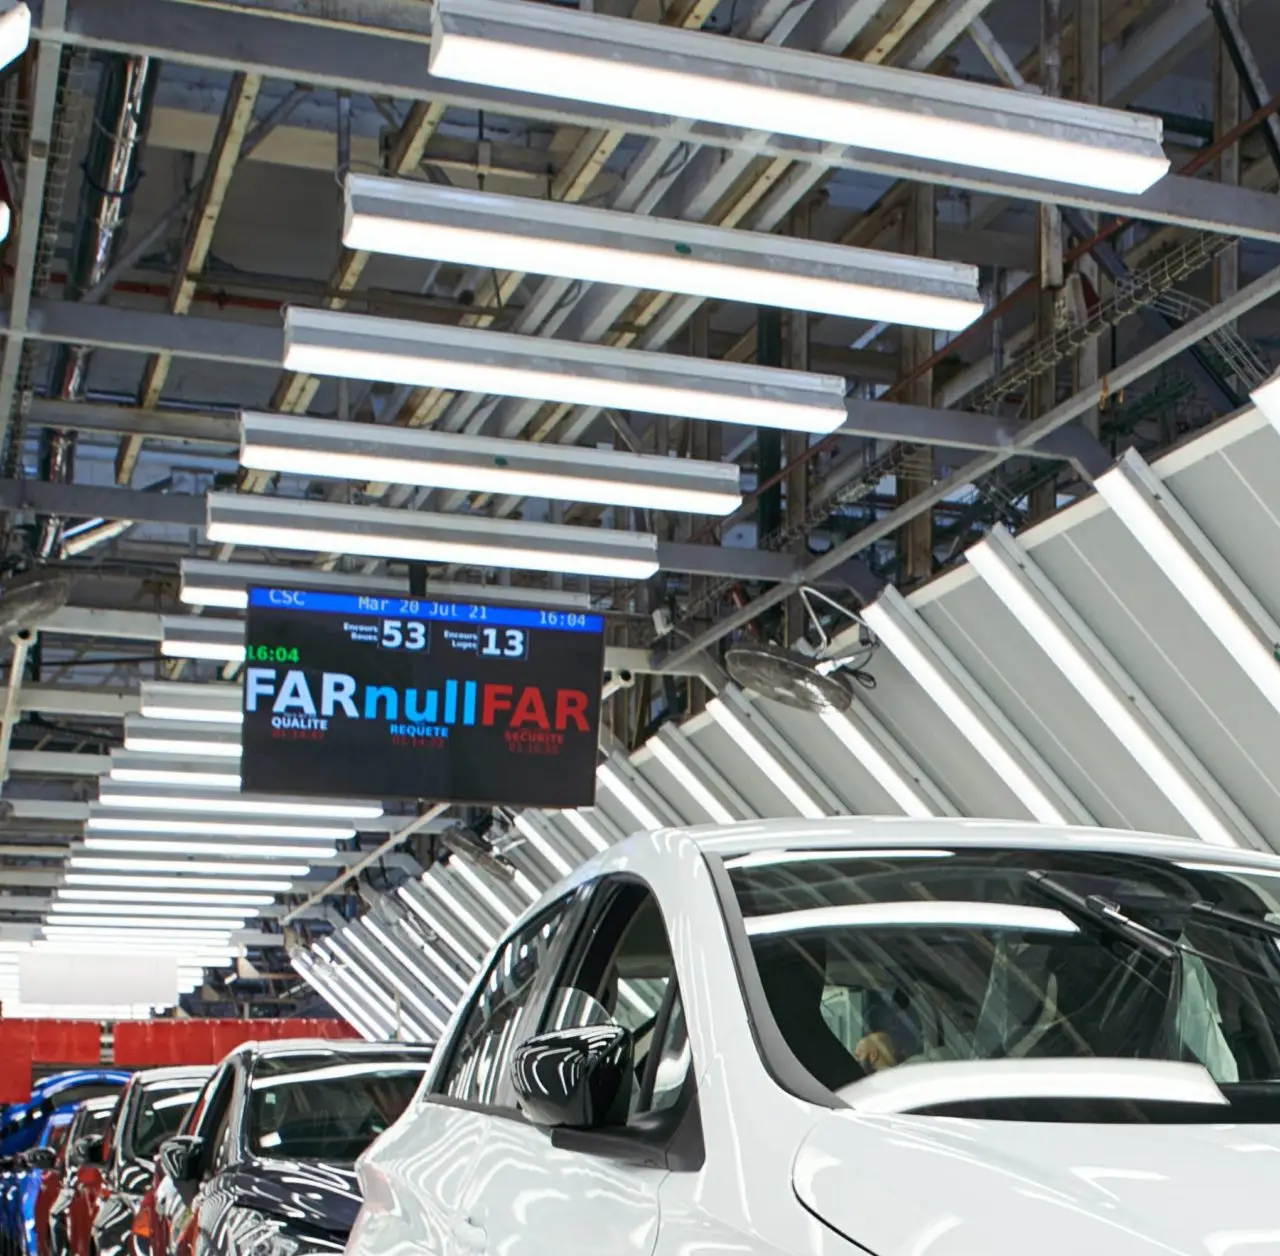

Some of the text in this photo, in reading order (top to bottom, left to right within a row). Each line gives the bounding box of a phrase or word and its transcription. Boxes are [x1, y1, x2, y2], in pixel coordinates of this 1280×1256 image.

[269, 589, 307, 607] CSC
[358, 595, 487, 619] Mar 20 Jul 21
[539, 610, 586, 627] 16:04
[382, 619, 426, 649] 53
[482, 627, 524, 657] 13
[247, 644, 300, 663] 16:04
[246, 667, 591, 732] FAR null FAR
